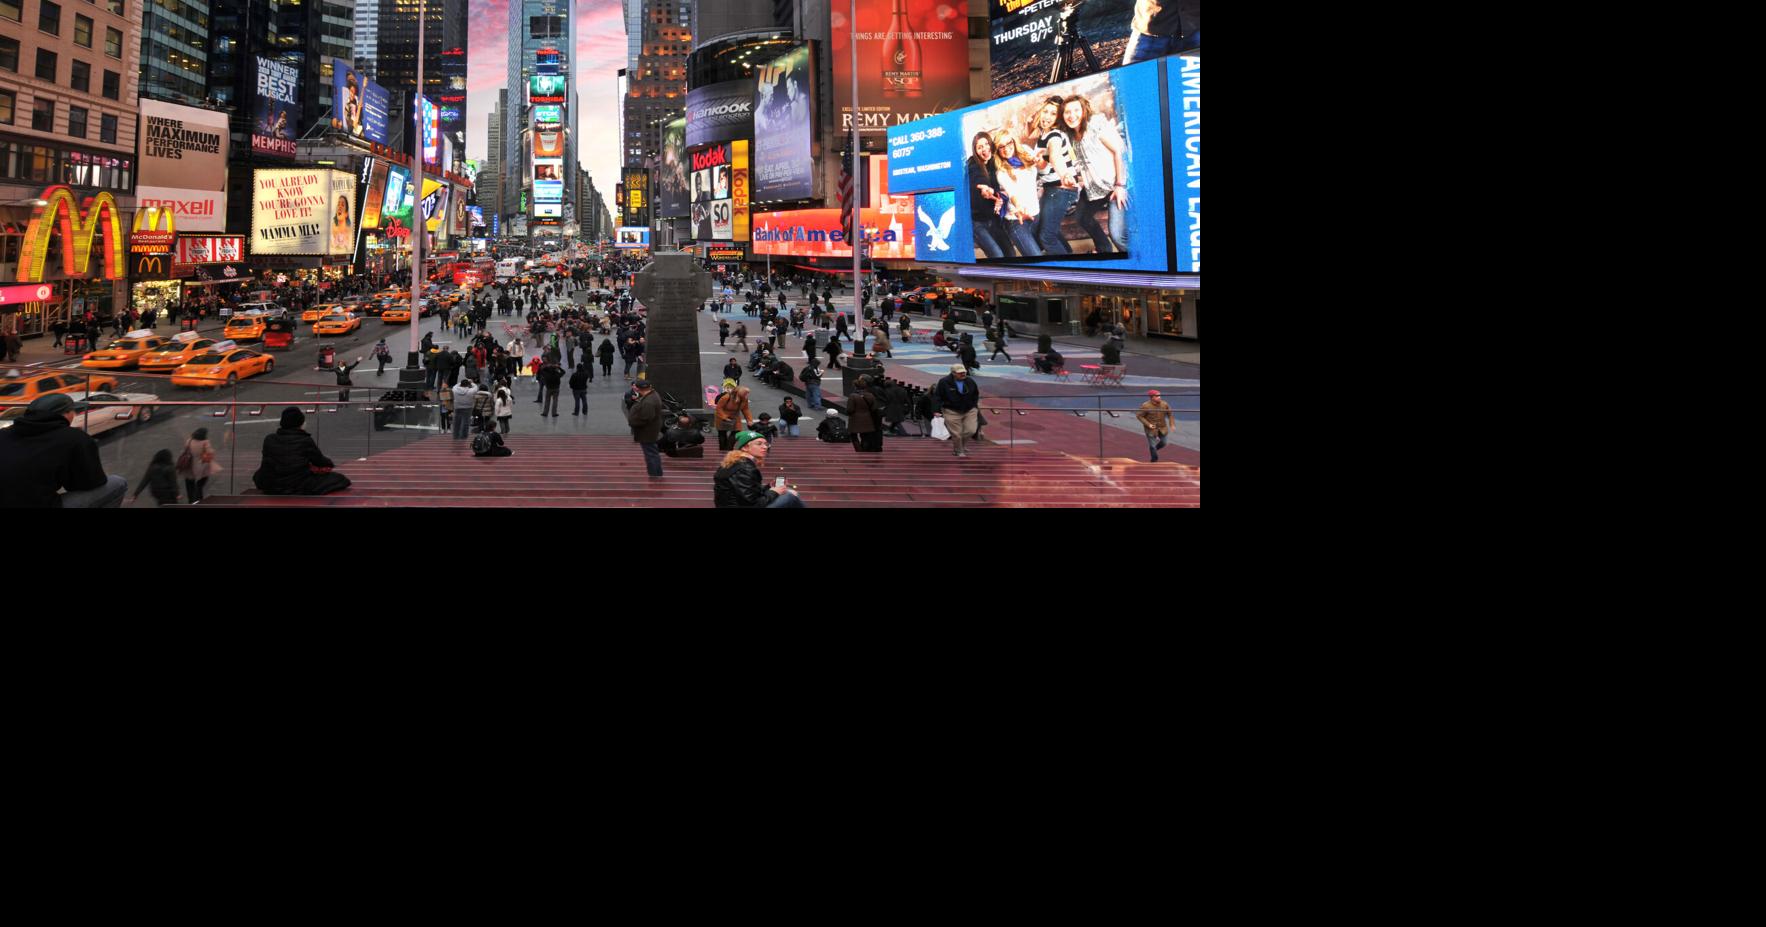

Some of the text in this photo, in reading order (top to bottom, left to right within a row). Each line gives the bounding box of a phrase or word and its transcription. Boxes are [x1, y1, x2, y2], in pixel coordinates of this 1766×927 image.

[874, 32, 886, 40] ARE
[994, 16, 1053, 45] THURSDAY
[256, 56, 299, 79] WINNER!
[257, 72, 297, 96] BEST
[257, 87, 297, 105] MUSICAL
[147, 115, 183, 129] WHERE
[147, 125, 220, 146] MAXIMUM
[252, 134, 297, 154] MEMPHIS
[145, 146, 183, 160] LIVES
[146, 137, 220, 154] PERFORMANCE
[693, 144, 726, 171] Kodak
[260, 179, 276, 189] YOU
[280, 175, 320, 188] ALREADY
[278, 187, 304, 198] KNOW
[733, 168, 748, 217] Kodak
[142, 199, 214, 216] maxell
[260, 195, 325, 211] YOU'RE GONNA
[275, 207, 312, 220] LOVE IT!
[260, 225, 297, 240] MAMMA
[299, 223, 320, 237] MIA!
[755, 225, 897, 243] Bank of Ameica
